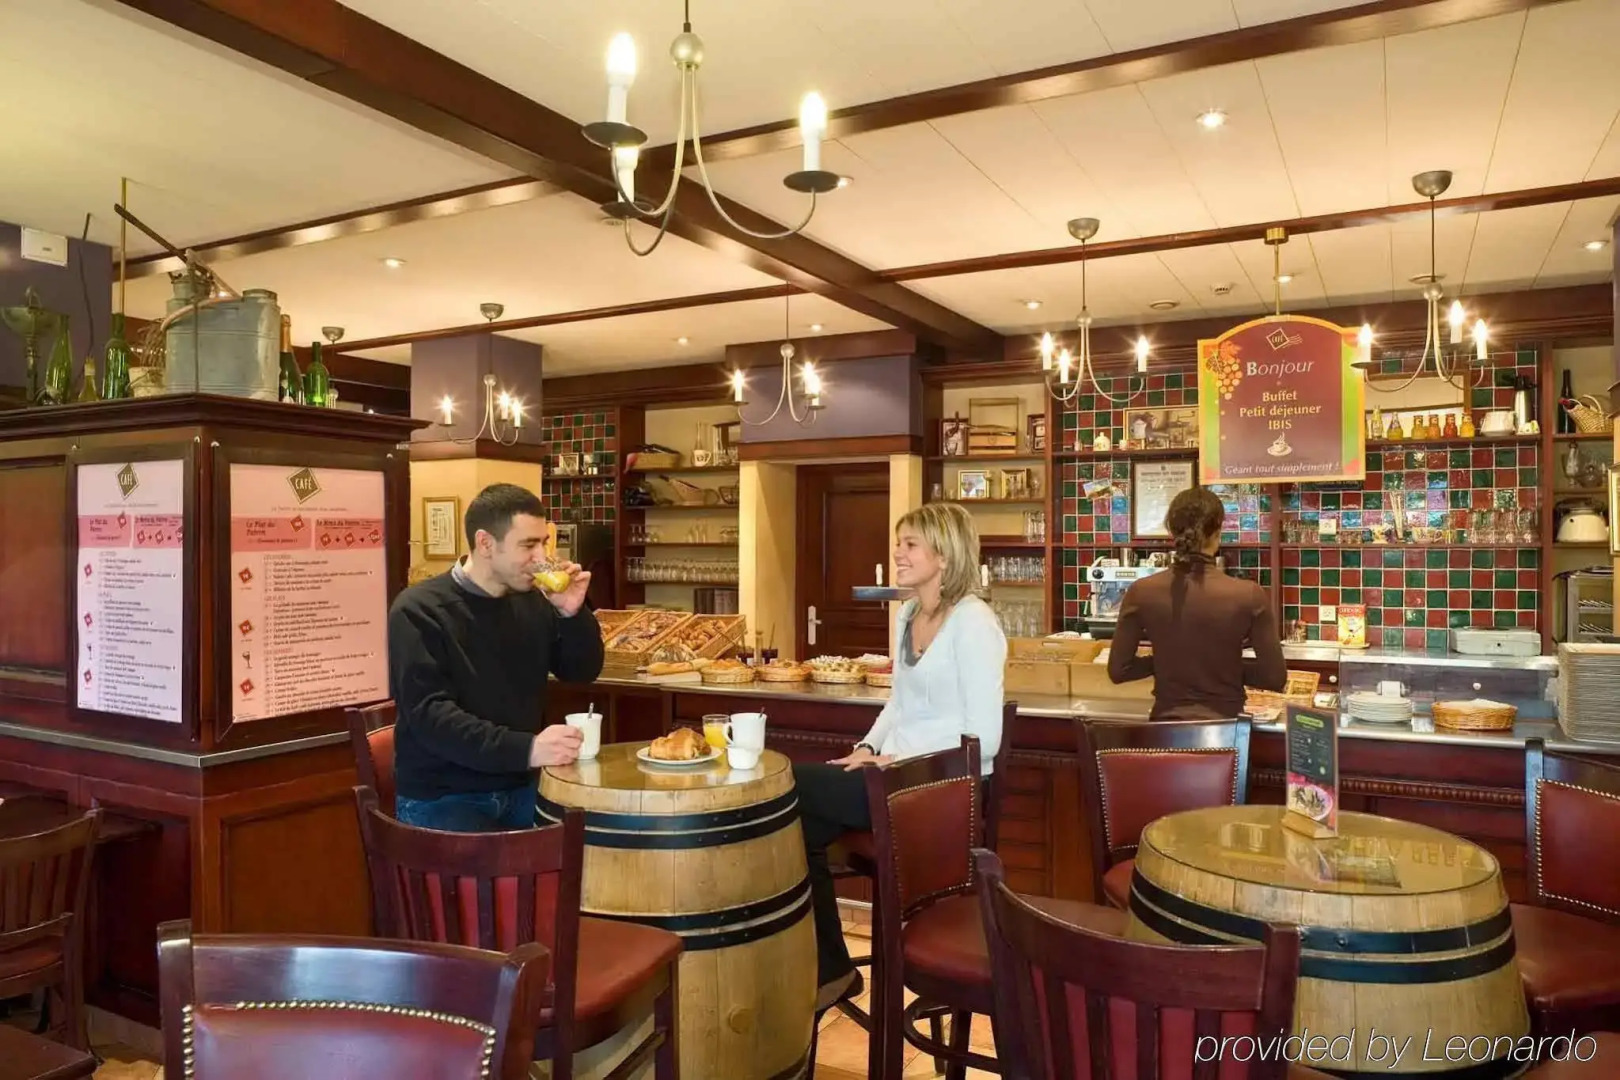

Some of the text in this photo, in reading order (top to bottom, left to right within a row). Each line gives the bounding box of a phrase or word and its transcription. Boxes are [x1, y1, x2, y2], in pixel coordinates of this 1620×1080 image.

[1246, 360, 1314, 378] Bonjour
[1262, 390, 1298, 402] Buffet
[1239, 404, 1322, 419] Petit déjeuner
[1268, 419, 1292, 431] IBIS
[1224, 464, 1253, 475] Géant
[1255, 464, 1275, 474] tout
[1277, 462, 1333, 475] simplement
[294, 477, 313, 490] CAFÉ
